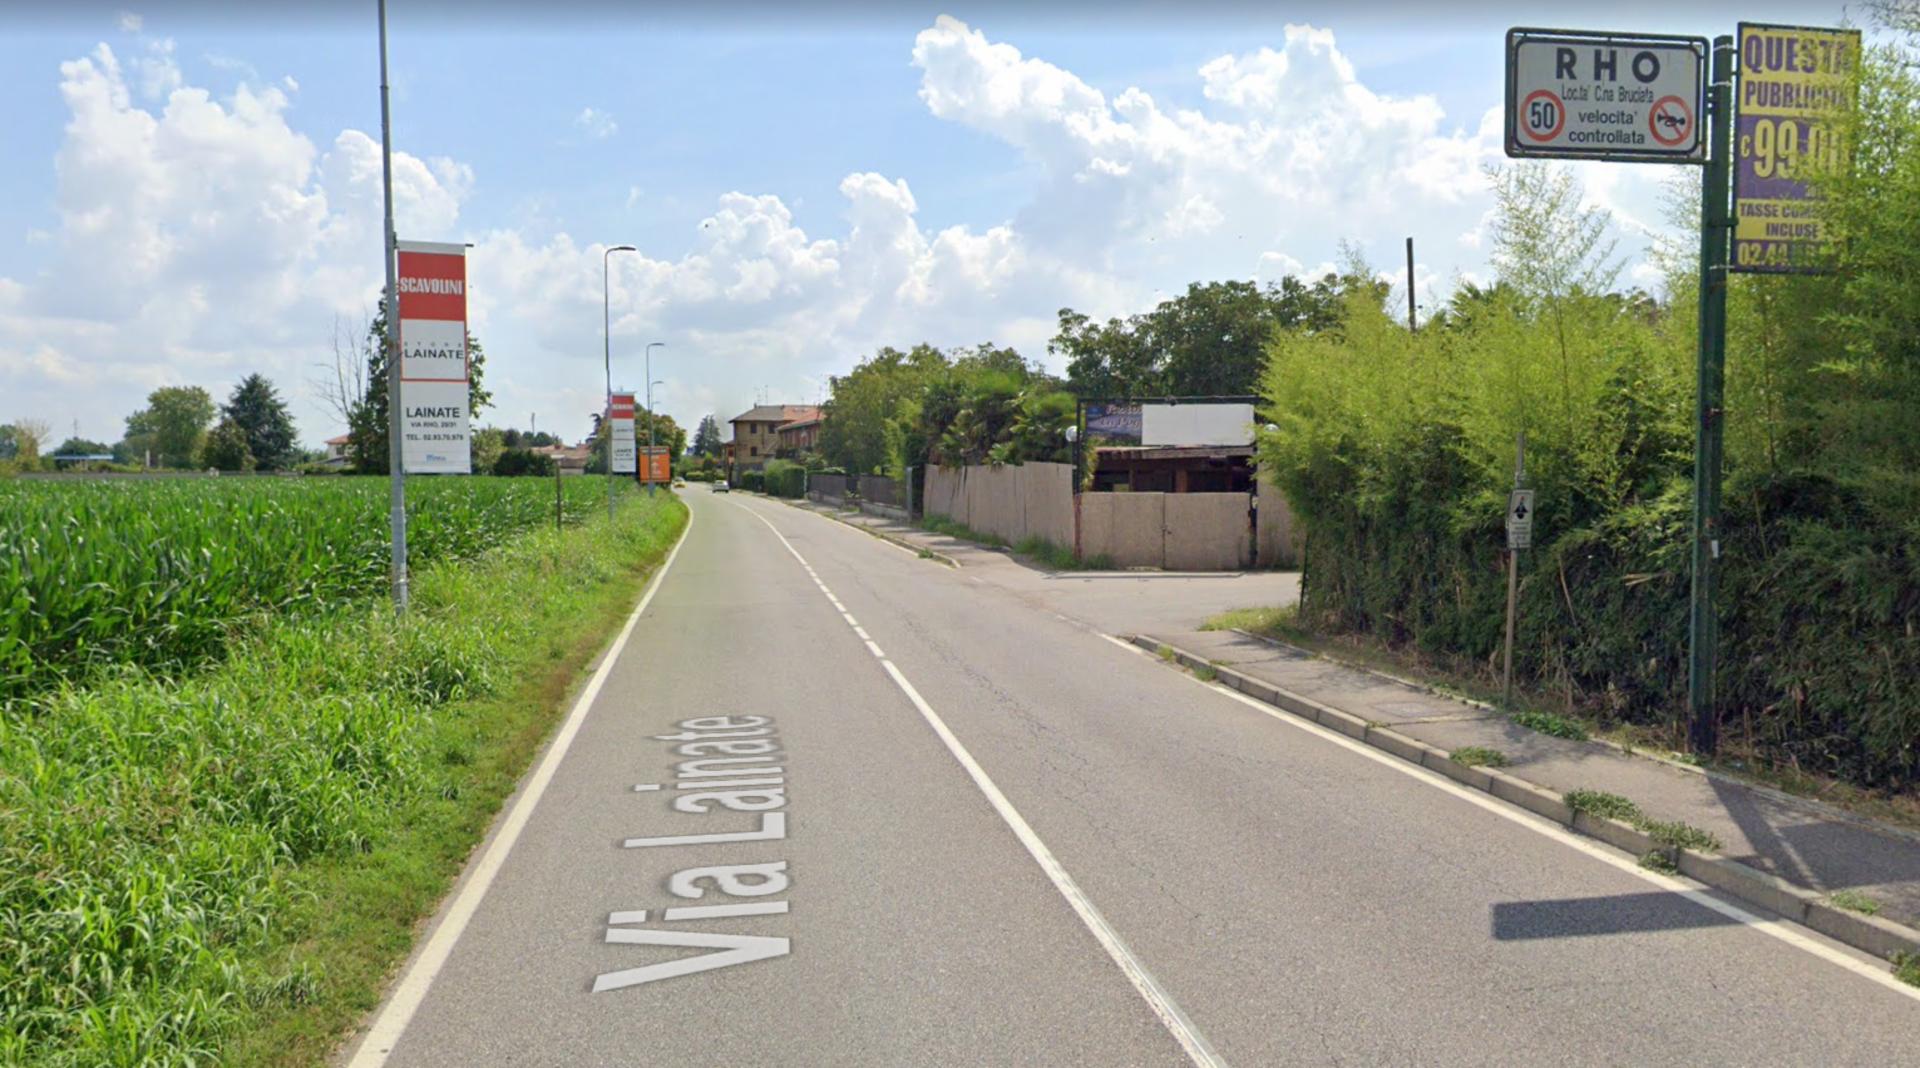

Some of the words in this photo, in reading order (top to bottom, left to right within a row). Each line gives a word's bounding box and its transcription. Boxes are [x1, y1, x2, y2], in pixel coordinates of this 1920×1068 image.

[1555, 47, 1660, 83] RHO
[1530, 102, 1555, 129] 50
[1568, 130, 1646, 145] controllata
[1740, 202, 1780, 218] TASSE
[1766, 222, 1819, 239] INCLUSE
[400, 276, 463, 296] SCAVOLINI
[404, 348, 465, 360] LAINATE
[405, 407, 461, 419] LAINATE
